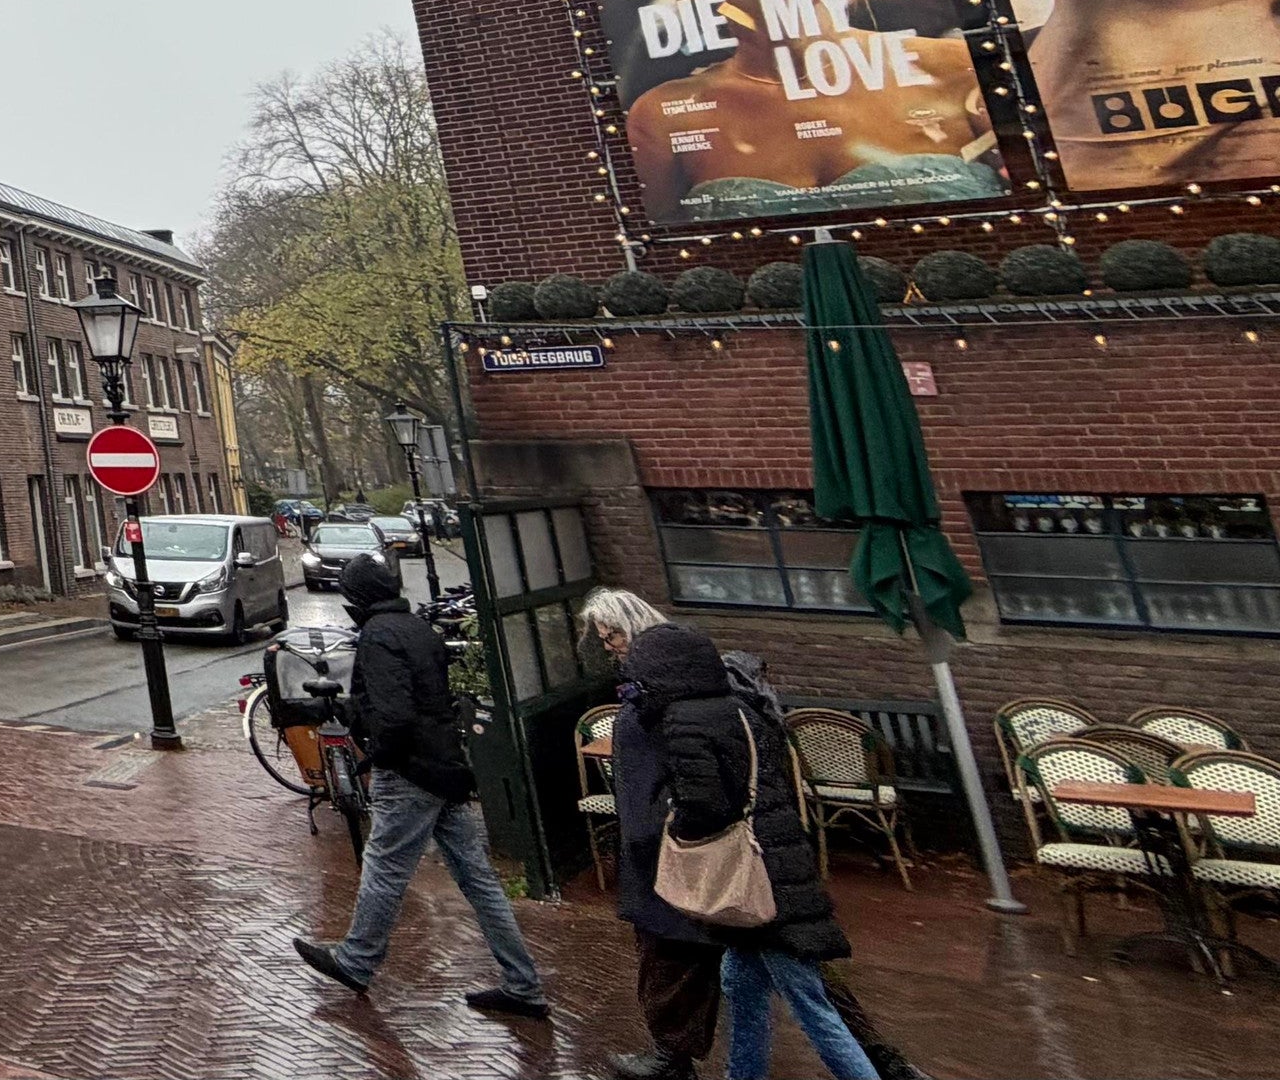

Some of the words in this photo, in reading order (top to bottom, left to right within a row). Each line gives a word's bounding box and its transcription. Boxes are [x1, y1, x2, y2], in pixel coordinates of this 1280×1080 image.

[774, 29, 936, 101] LOVE
[774, 187, 806, 197] VANAF
[807, 186, 820, 195] 20
[822, 181, 877, 193] NOVEMBER
[878, 180, 890, 188] IN
[891, 178, 906, 187] DE
[907, 173, 962, 185] BIOSCOOP
[491, 350, 594, 366] TOLSTEEGBRUG
